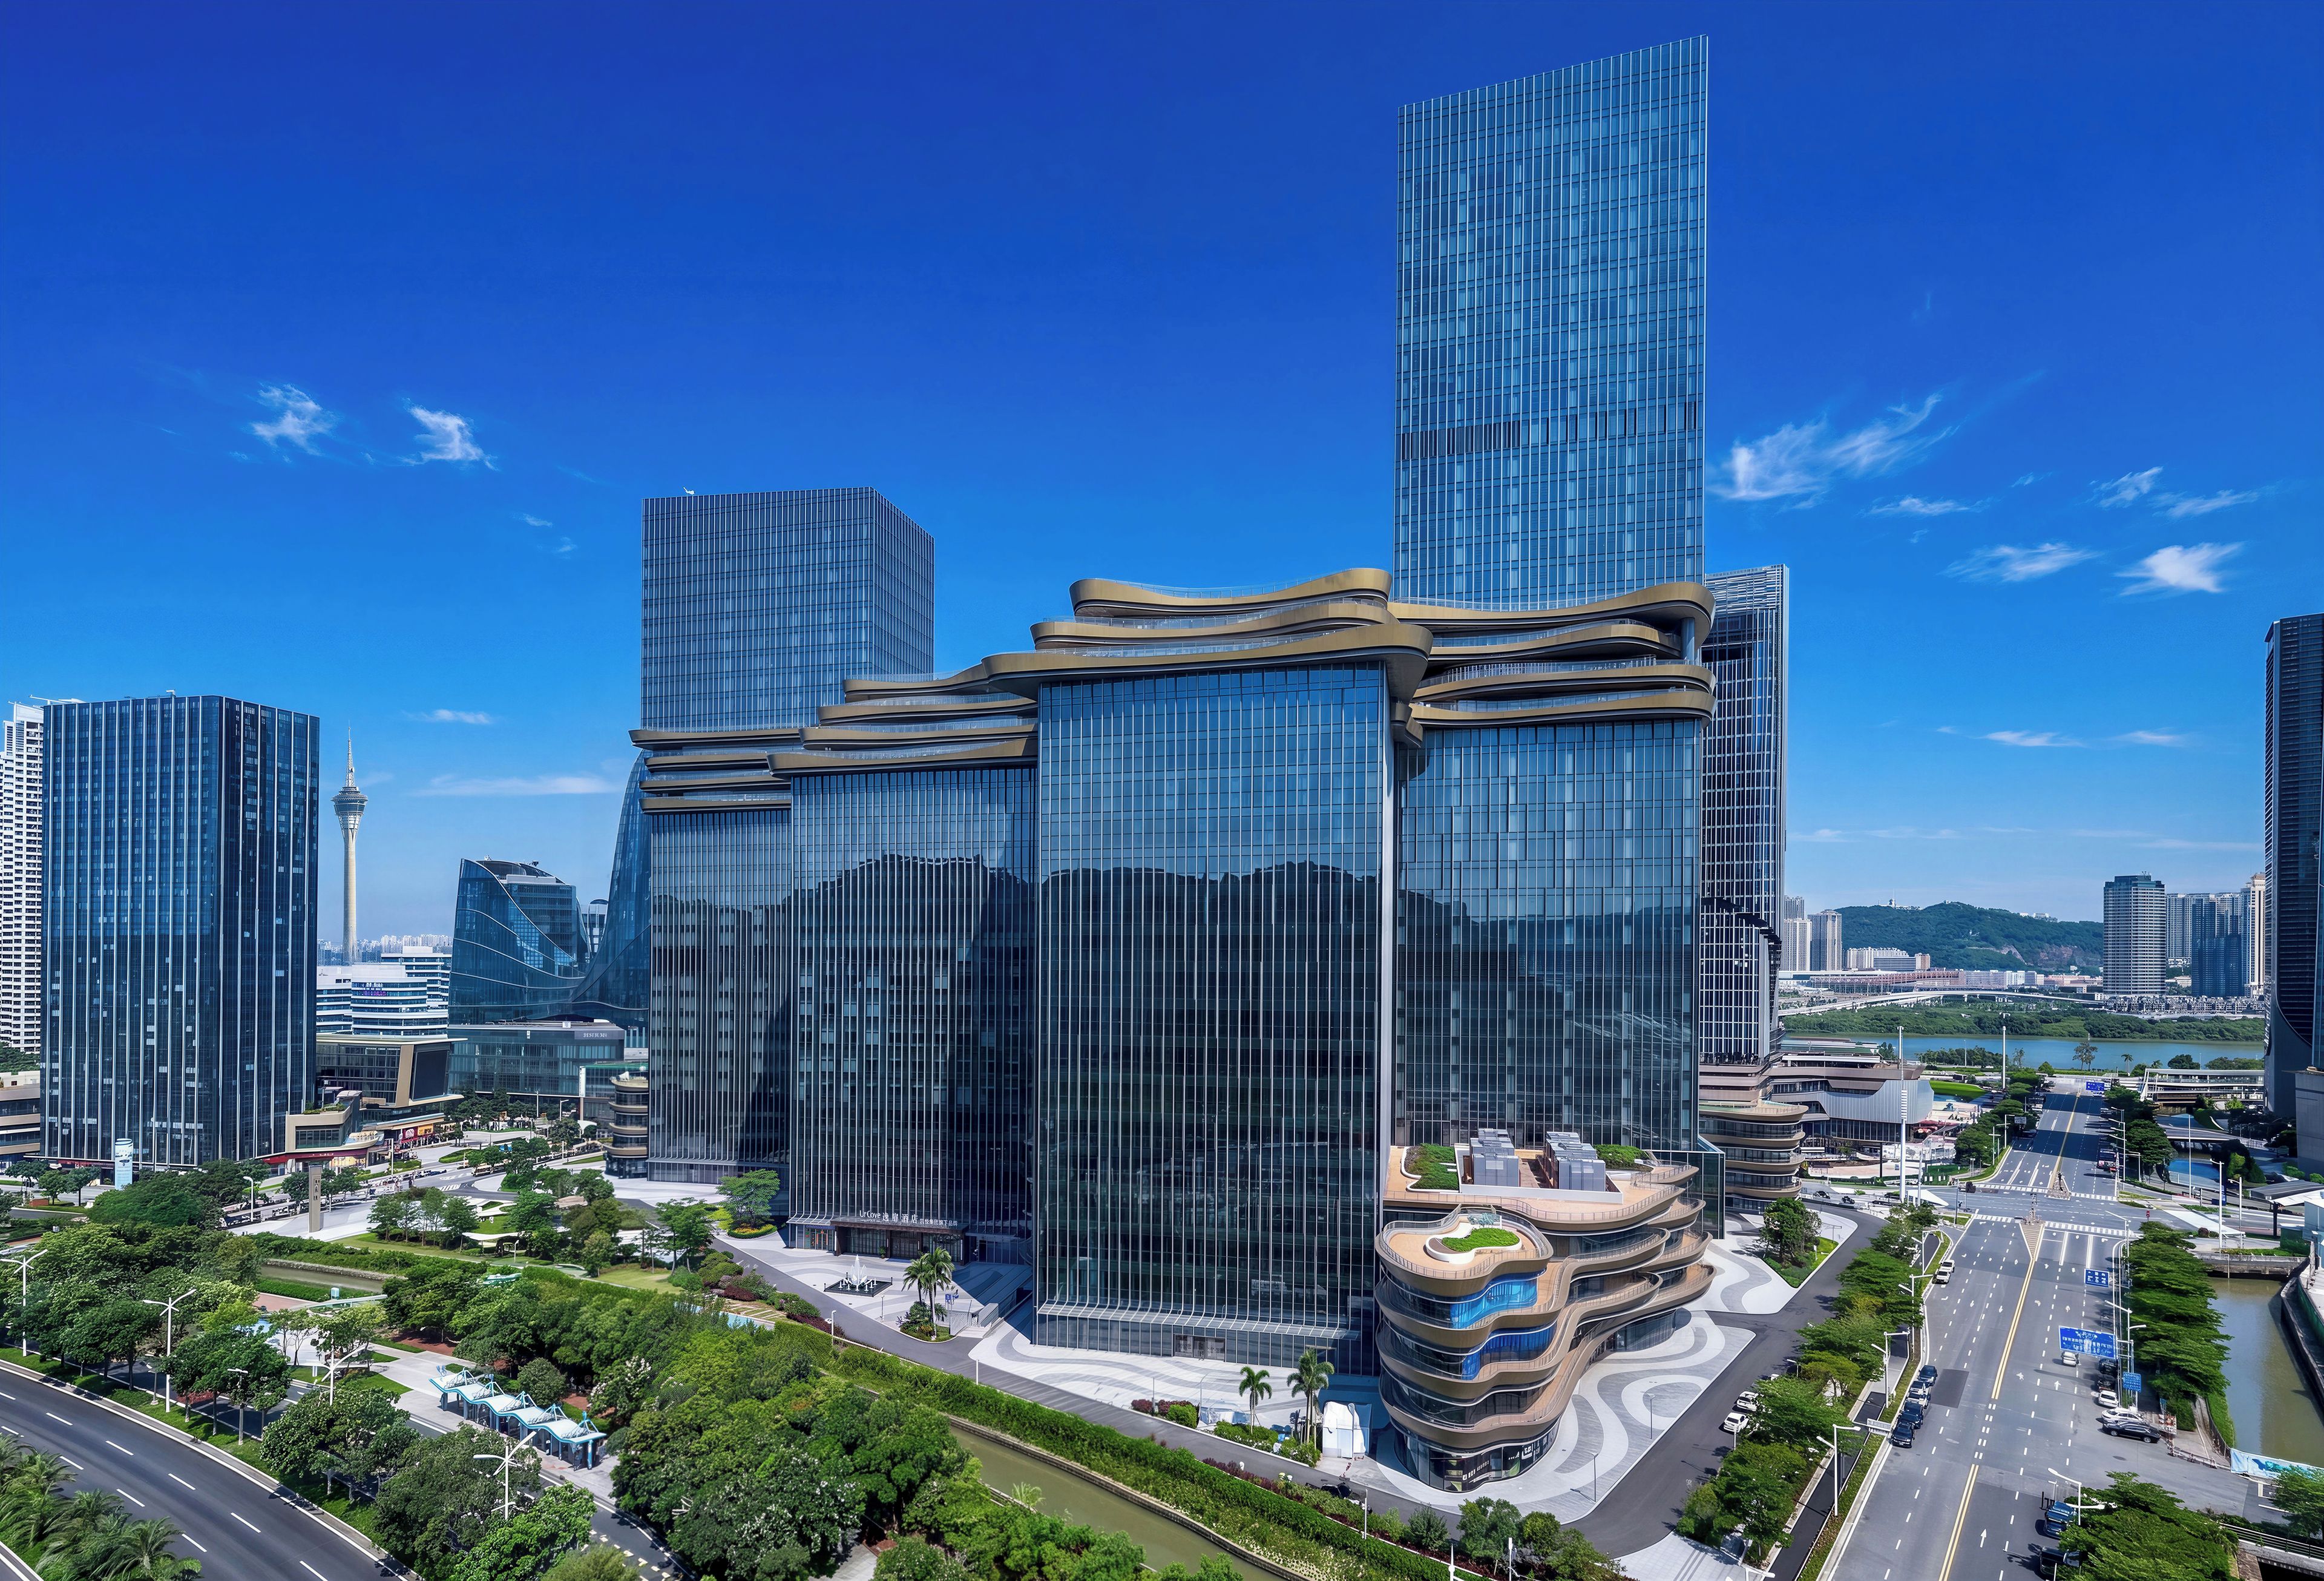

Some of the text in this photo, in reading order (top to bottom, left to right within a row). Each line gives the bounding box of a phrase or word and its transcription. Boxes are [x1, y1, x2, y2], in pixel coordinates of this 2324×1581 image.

[859, 1210, 881, 1218] UrCove
[882, 1212, 918, 1223] 逸扉酒店
